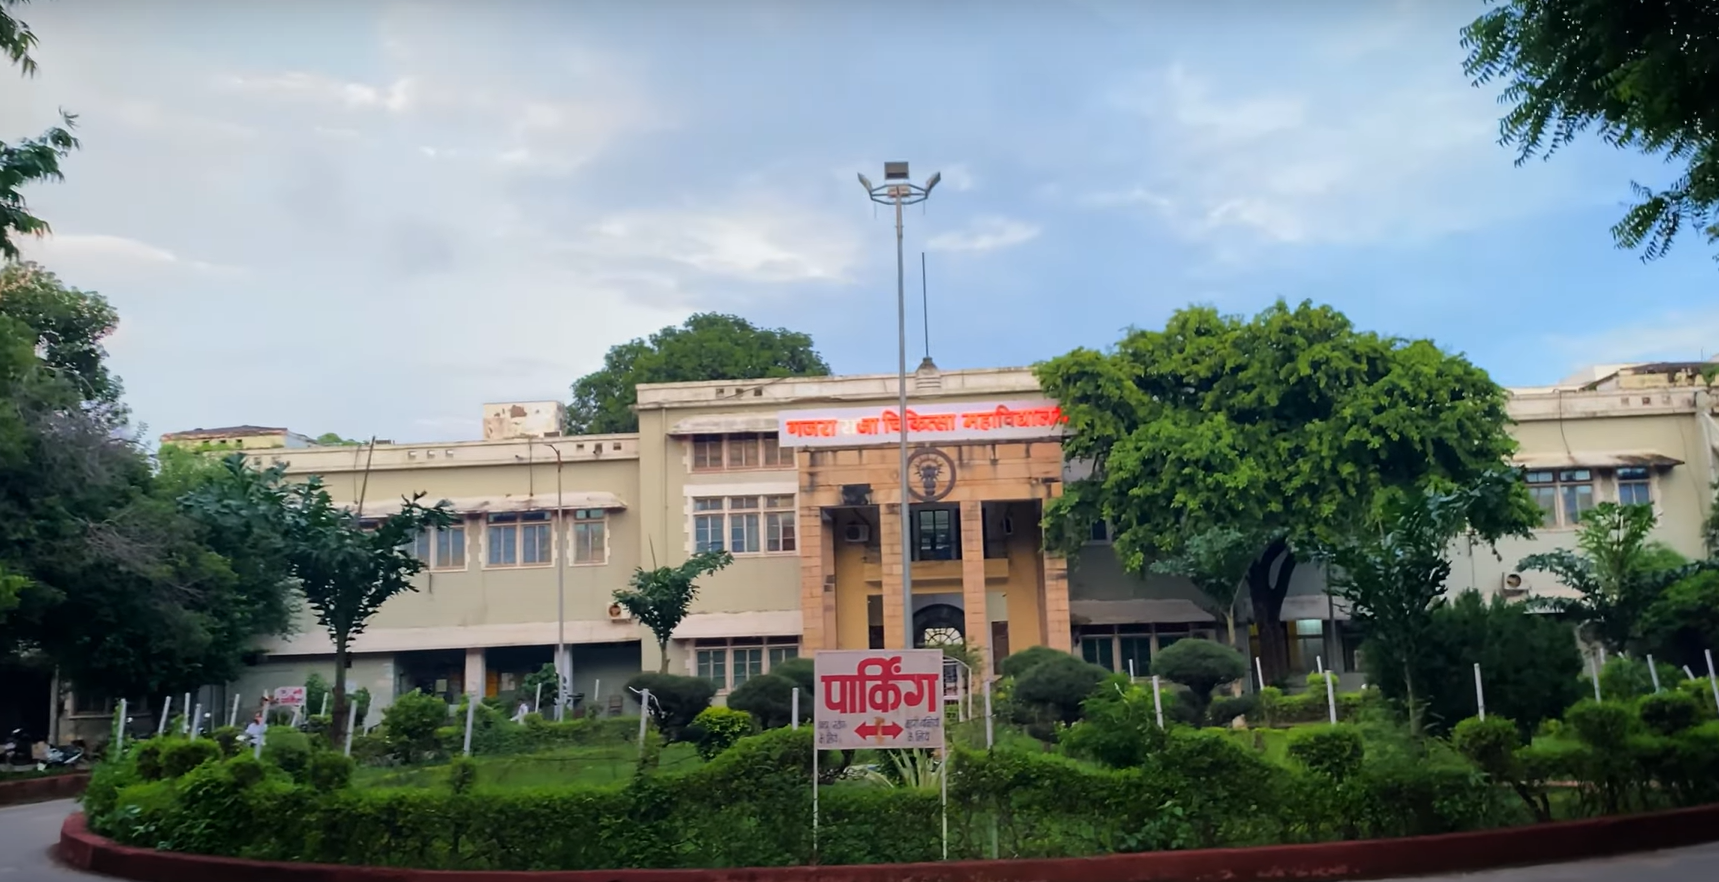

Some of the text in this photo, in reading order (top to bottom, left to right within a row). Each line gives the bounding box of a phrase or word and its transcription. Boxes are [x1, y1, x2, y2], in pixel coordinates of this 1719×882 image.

[786, 420, 838, 437] गजरा
[882, 409, 956, 434] चिकित्सा
[820, 656, 939, 714] पार्किंग
